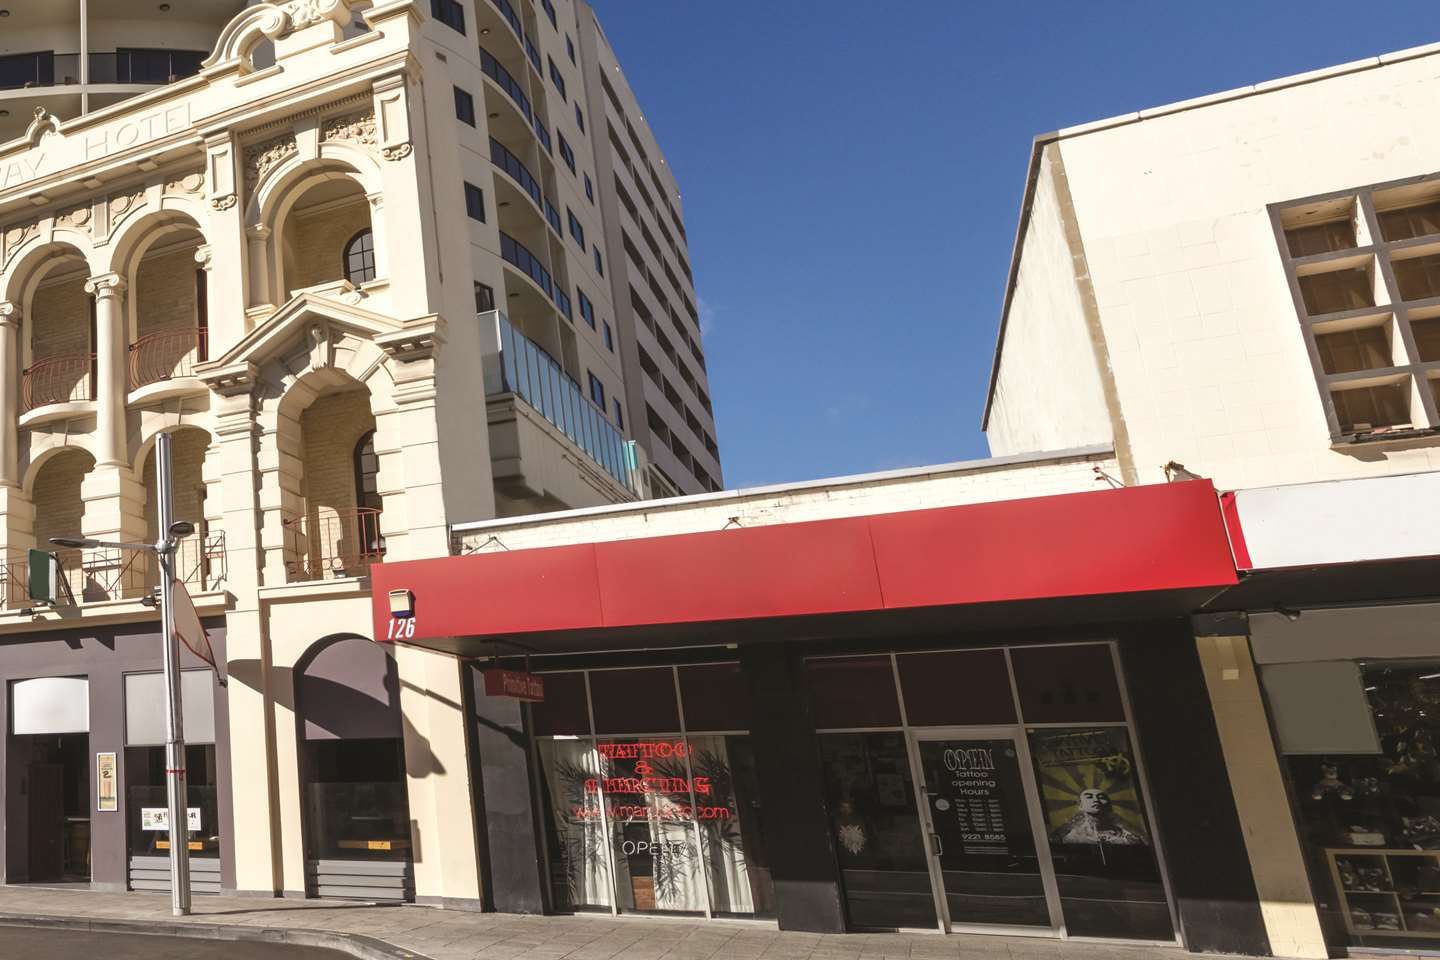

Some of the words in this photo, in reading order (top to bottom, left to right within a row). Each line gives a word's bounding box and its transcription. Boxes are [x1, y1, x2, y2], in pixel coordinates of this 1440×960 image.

[387, 617, 416, 639] 126
[598, 742, 694, 759] TATTOO
[943, 748, 995, 771] OPEN
[634, 760, 654, 775] &
[584, 776, 713, 795] PIERCING
[951, 780, 996, 788] opening
